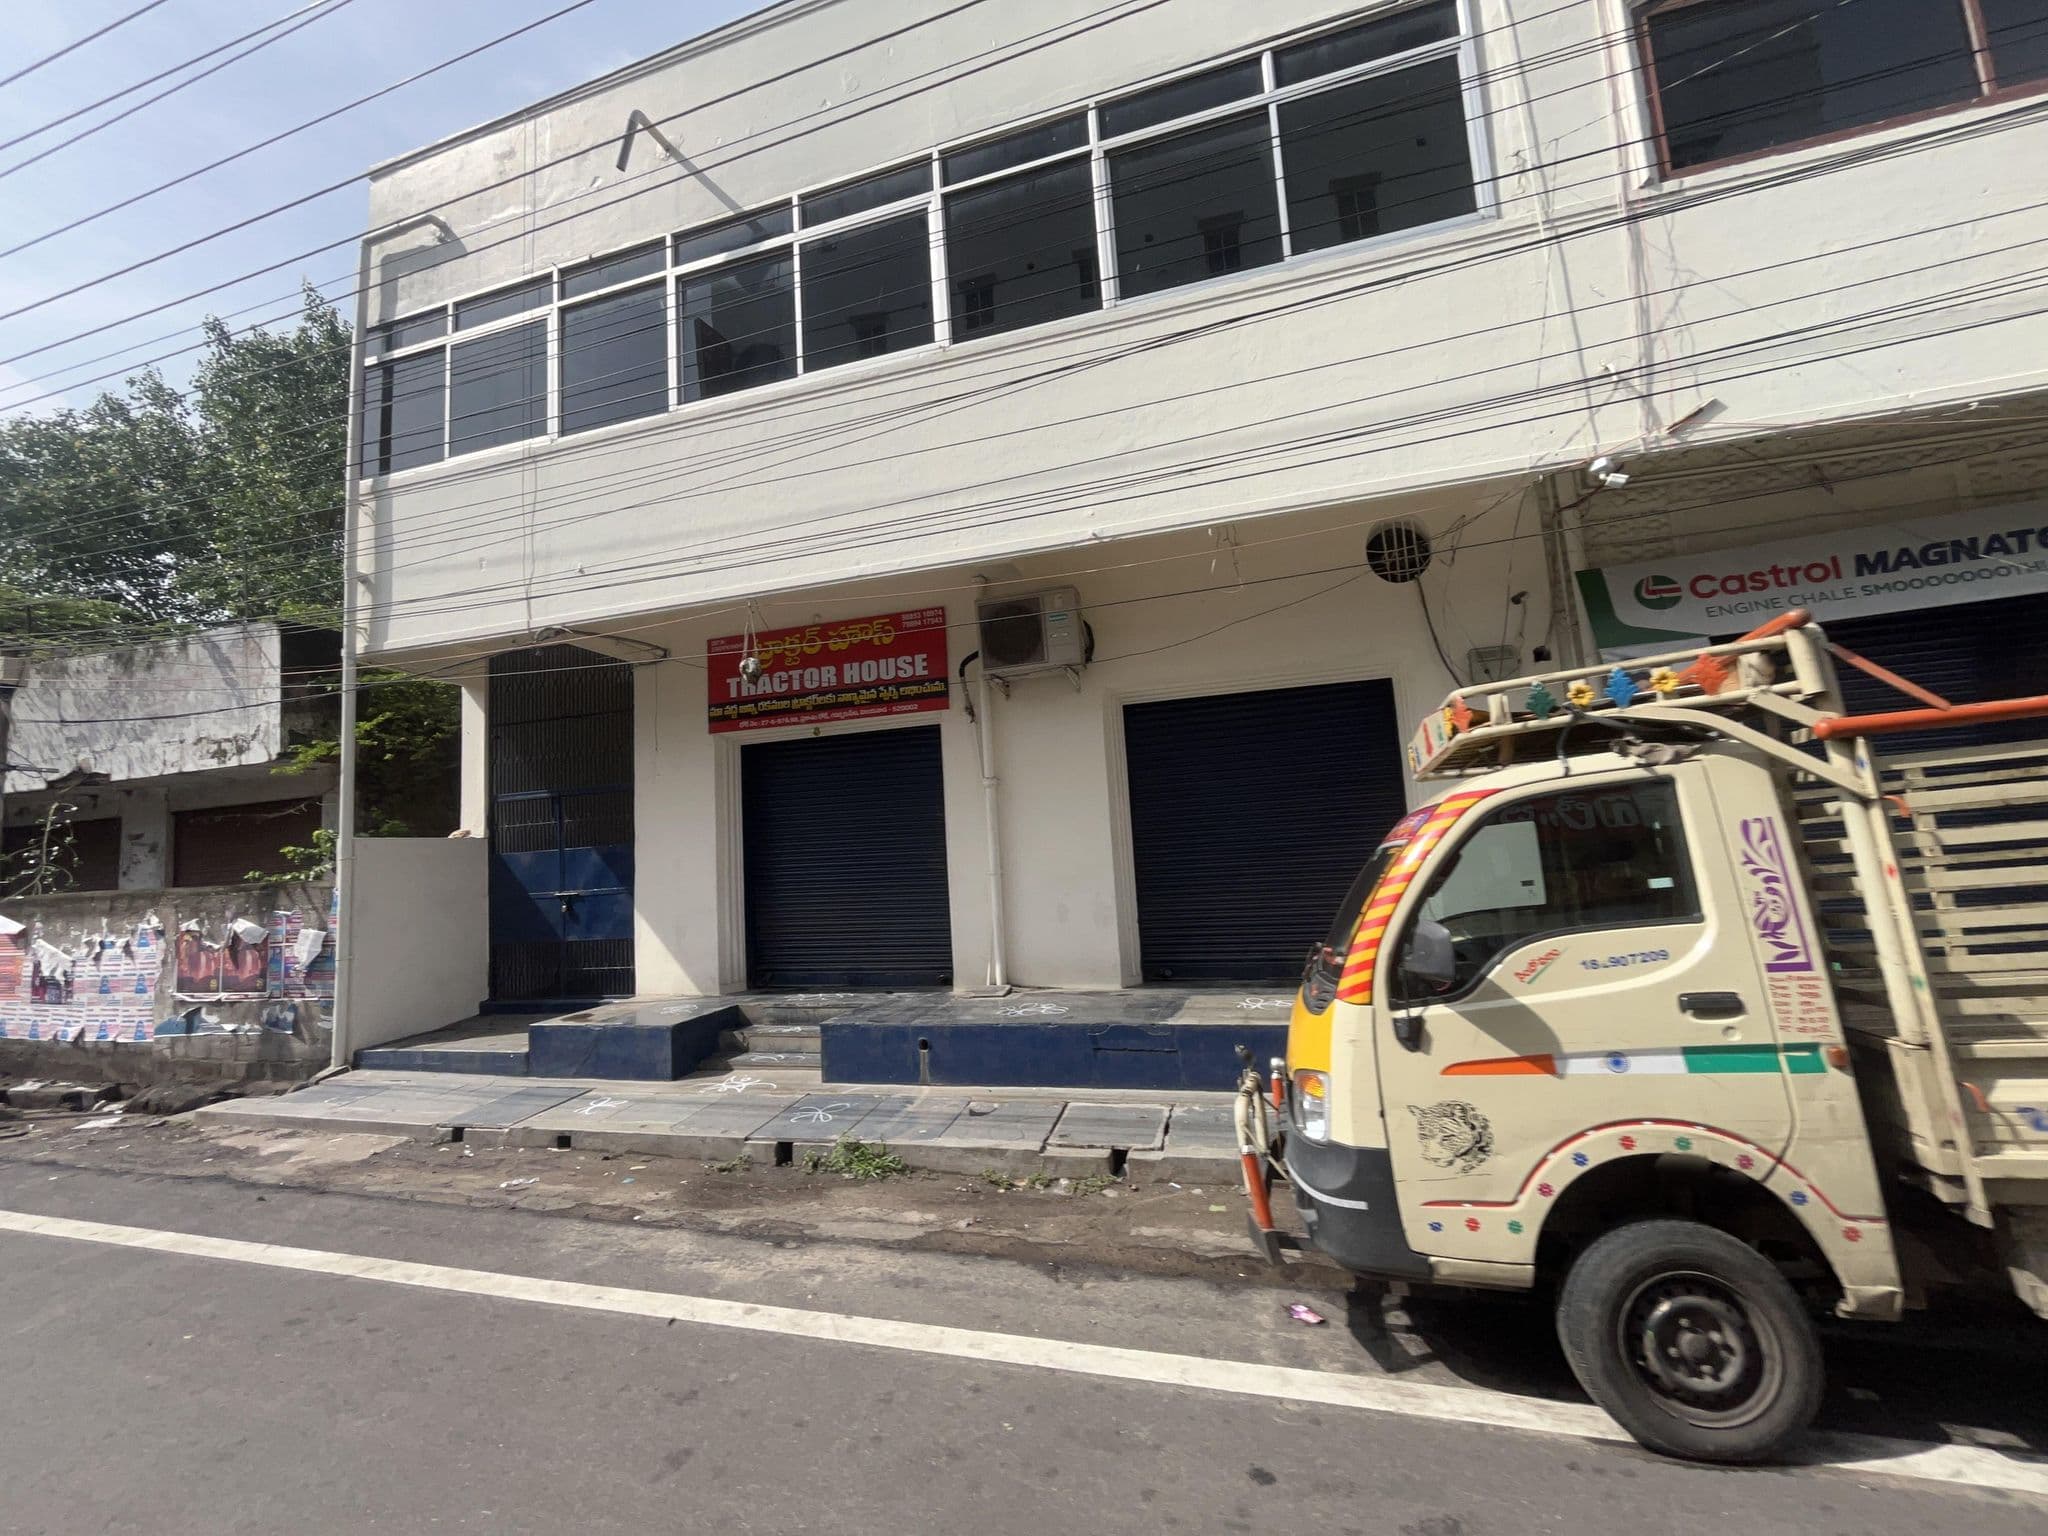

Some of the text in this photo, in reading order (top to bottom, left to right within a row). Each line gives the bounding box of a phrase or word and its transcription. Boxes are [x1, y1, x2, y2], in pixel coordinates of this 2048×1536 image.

[1689, 555, 1842, 599] Castrol
[1705, 595, 1783, 618] ENGINE
[1788, 586, 1857, 607] CHALE
[726, 653, 930, 698] TRACTOR HOUSE
